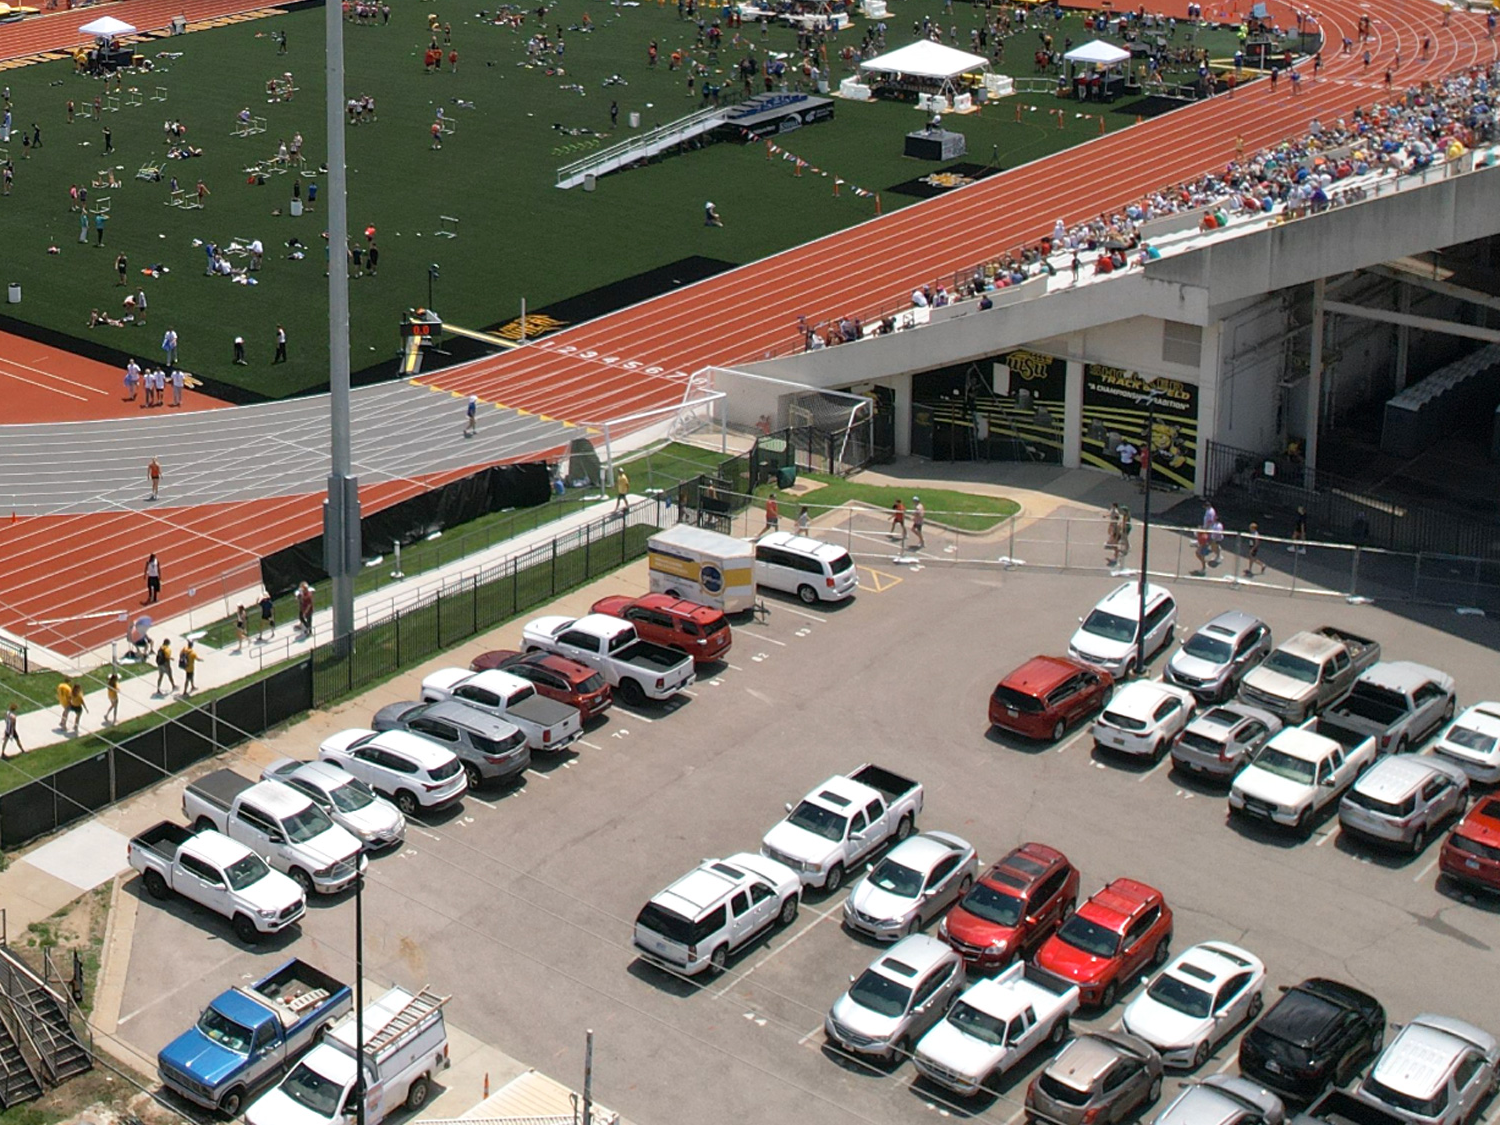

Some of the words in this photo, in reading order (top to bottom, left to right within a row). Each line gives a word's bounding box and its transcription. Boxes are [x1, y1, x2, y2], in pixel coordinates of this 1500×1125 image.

[557, 345, 578, 354] 2
[579, 351, 599, 360] 3
[623, 361, 644, 370] 5
[645, 366, 664, 375] 6
[1101, 375, 1141, 390] TRACK
[612, 728, 630, 740] 79
[455, 816, 475, 828] 76
